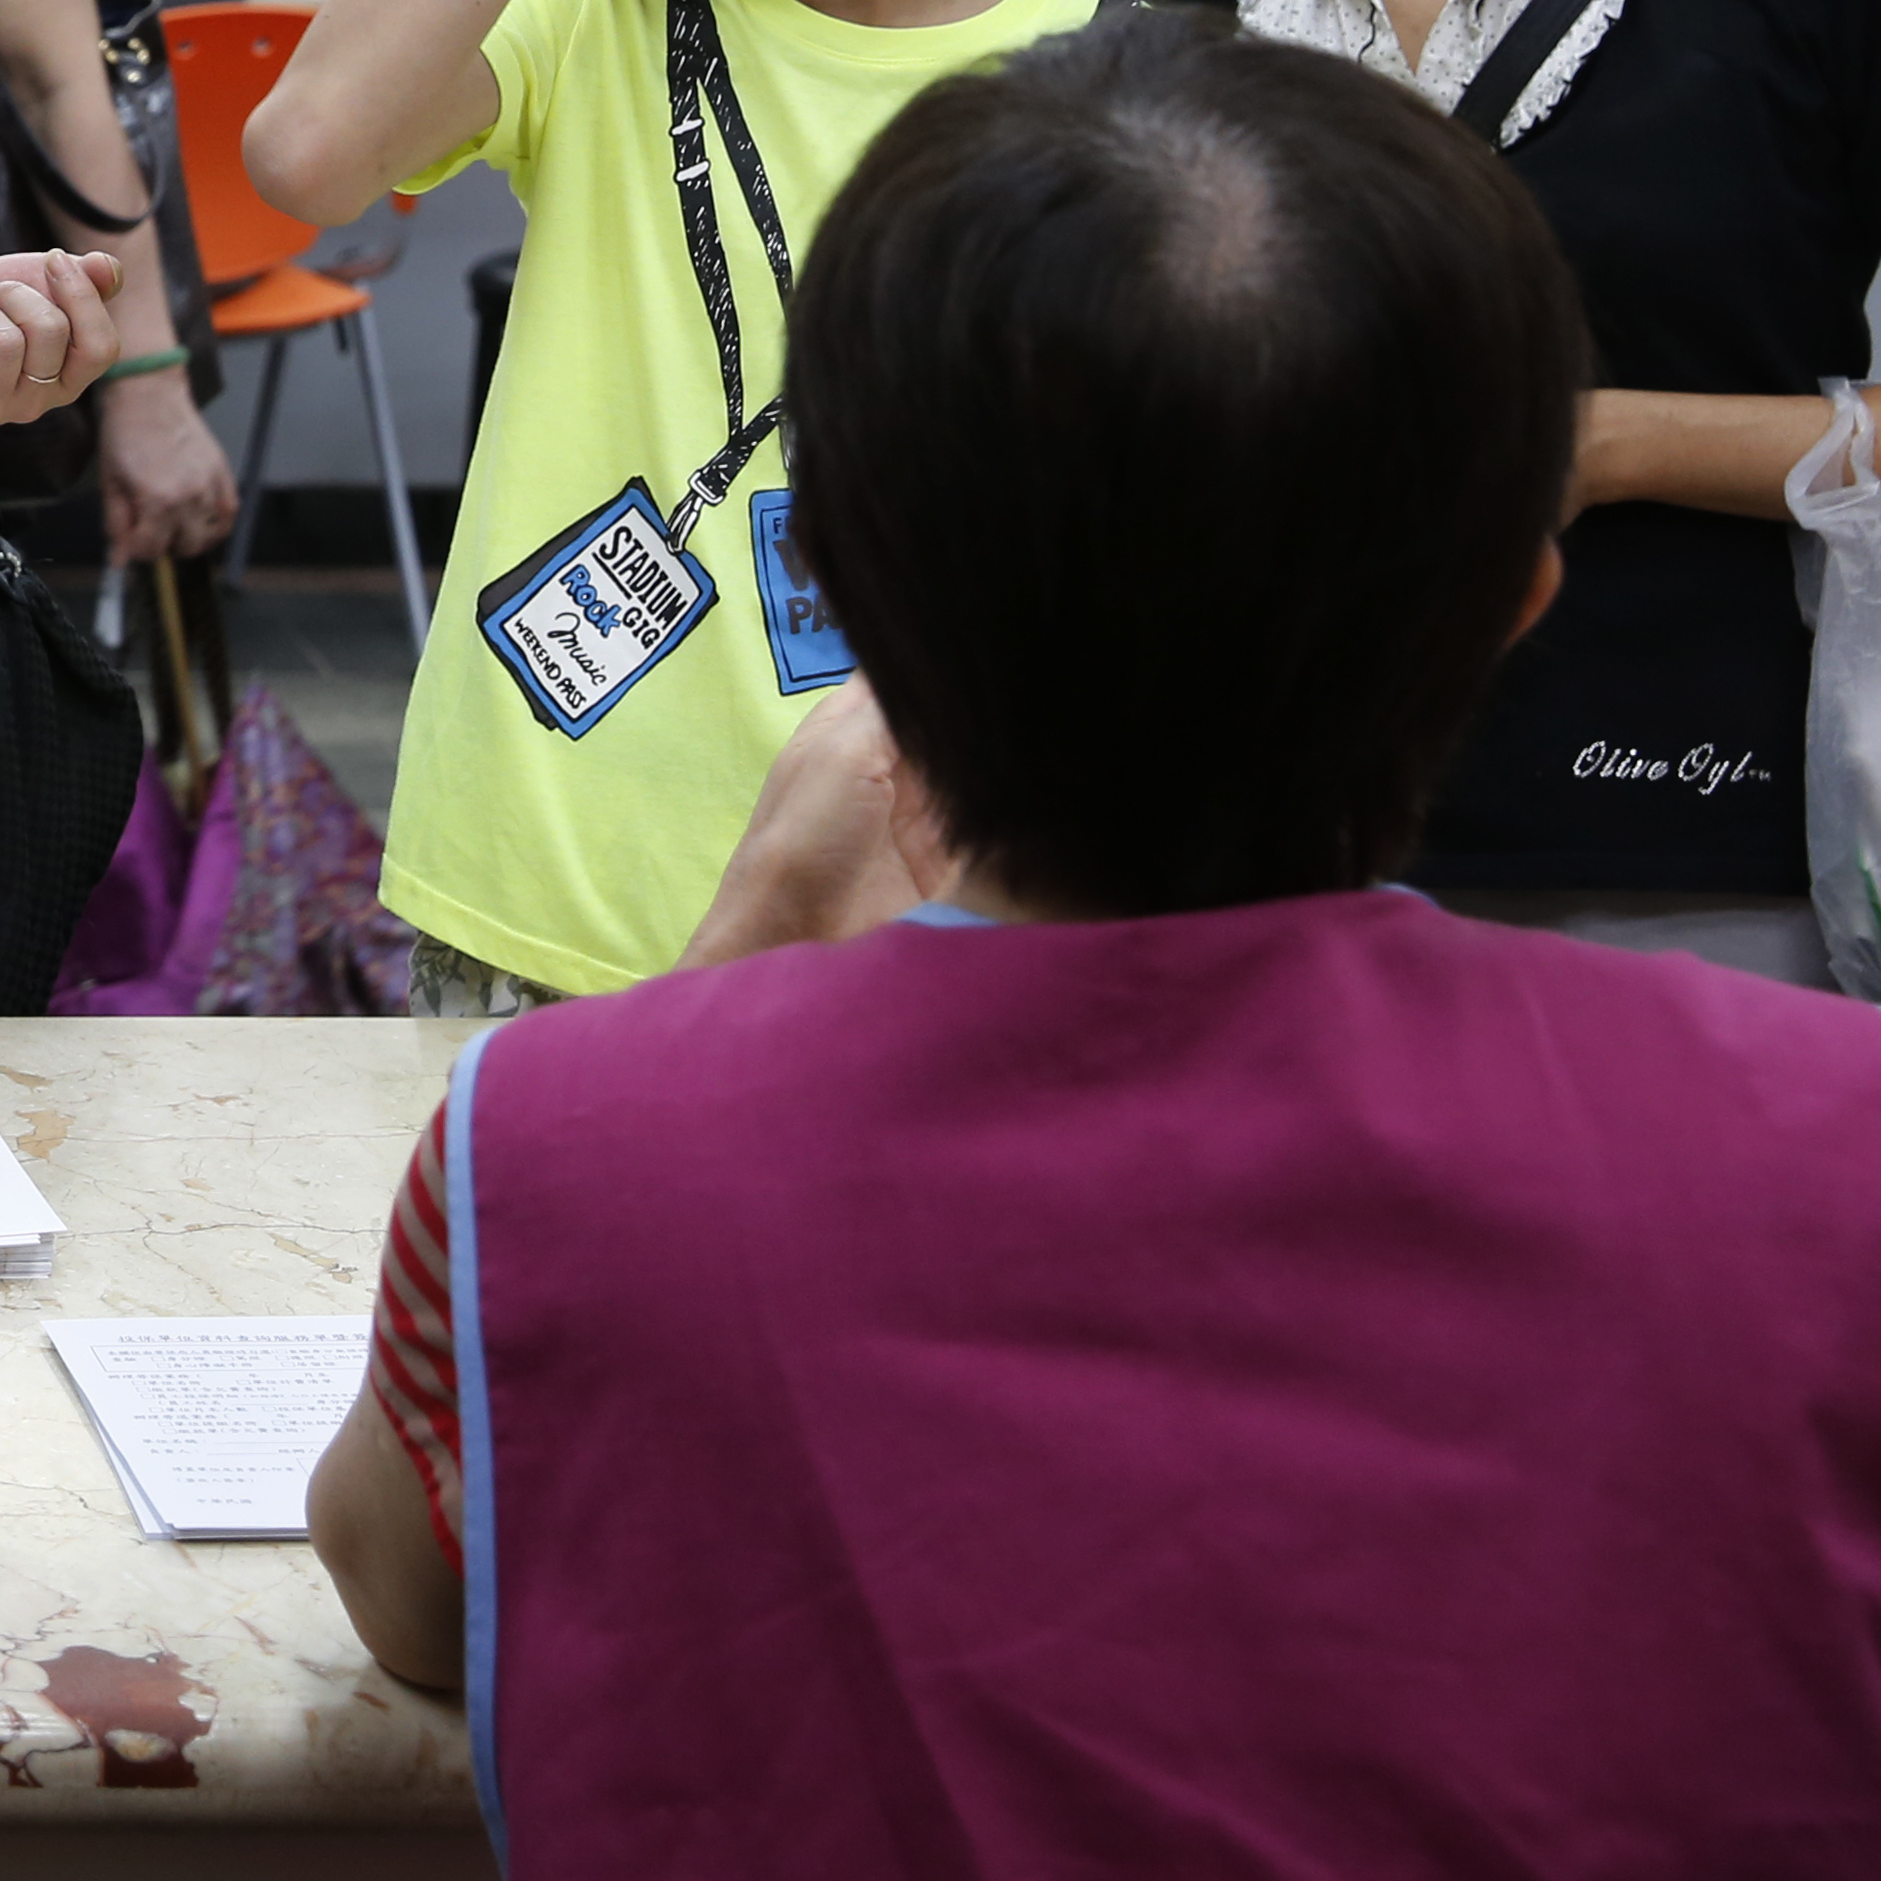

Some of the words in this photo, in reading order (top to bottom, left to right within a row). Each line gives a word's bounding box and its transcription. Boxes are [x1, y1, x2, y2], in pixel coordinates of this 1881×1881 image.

[599, 525, 688, 631] STADIUM
[621, 605, 661, 650] GIG
[1572, 740, 1669, 781] Olive
